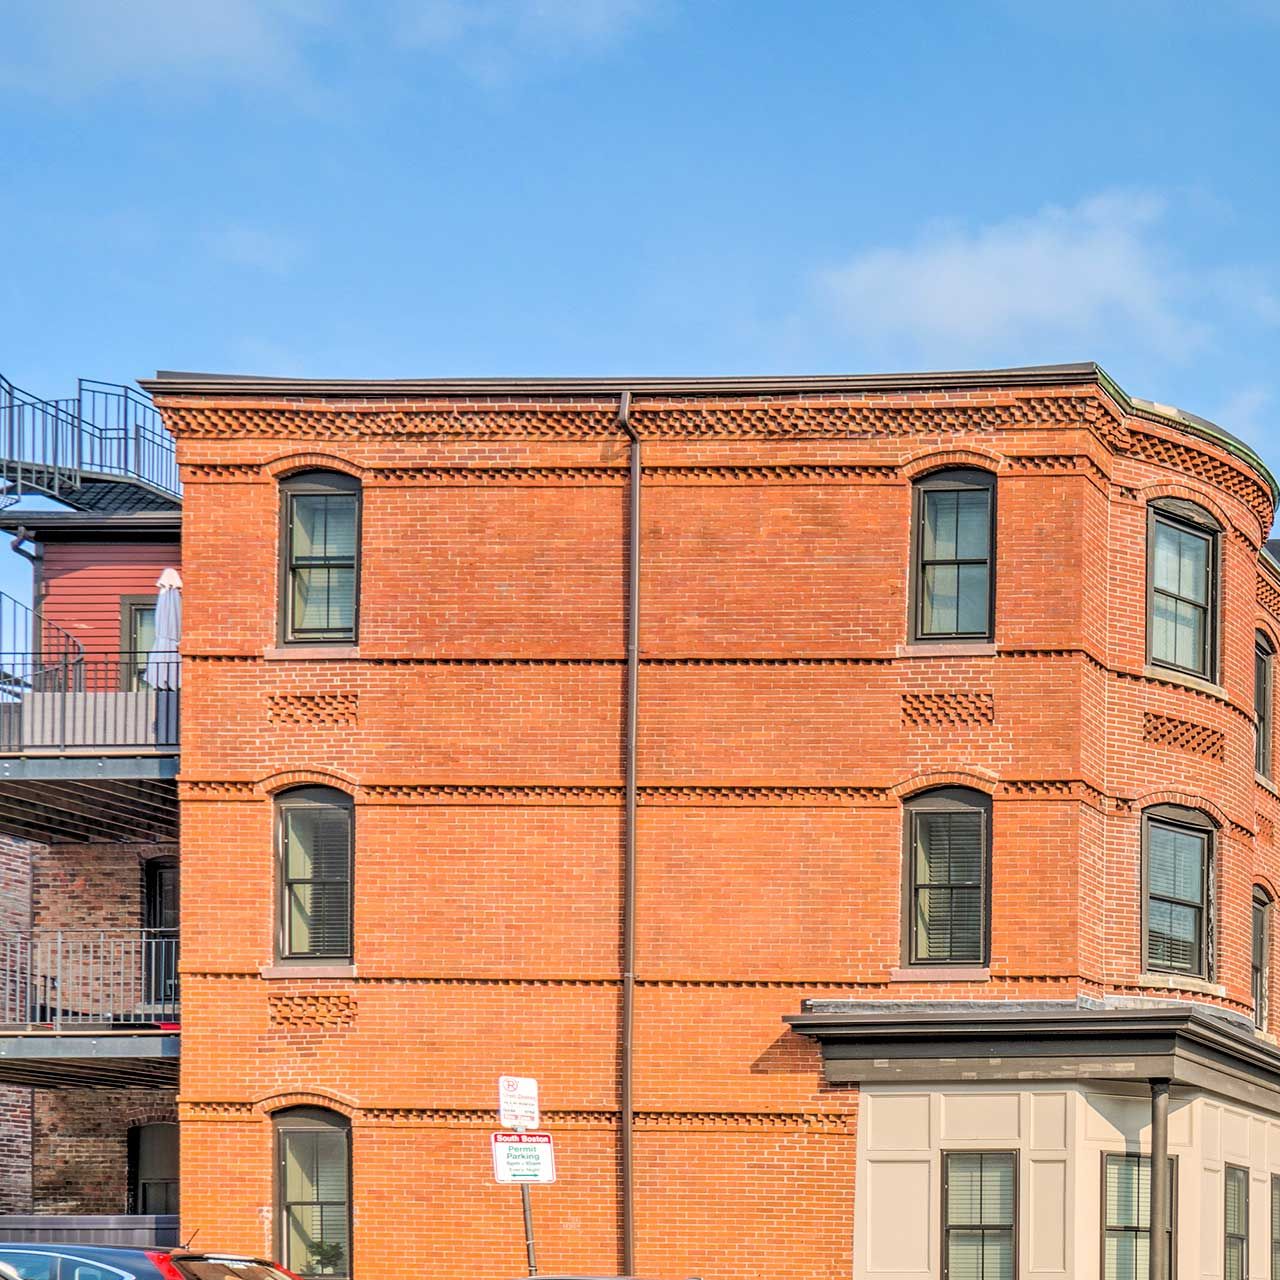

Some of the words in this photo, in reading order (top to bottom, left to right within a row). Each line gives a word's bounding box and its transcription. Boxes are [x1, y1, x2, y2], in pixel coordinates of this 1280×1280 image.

[496, 1134, 519, 1142] South
[521, 1135, 549, 1143] Boston
[508, 1145, 537, 1153] Permit
[506, 1153, 540, 1161] Parking
